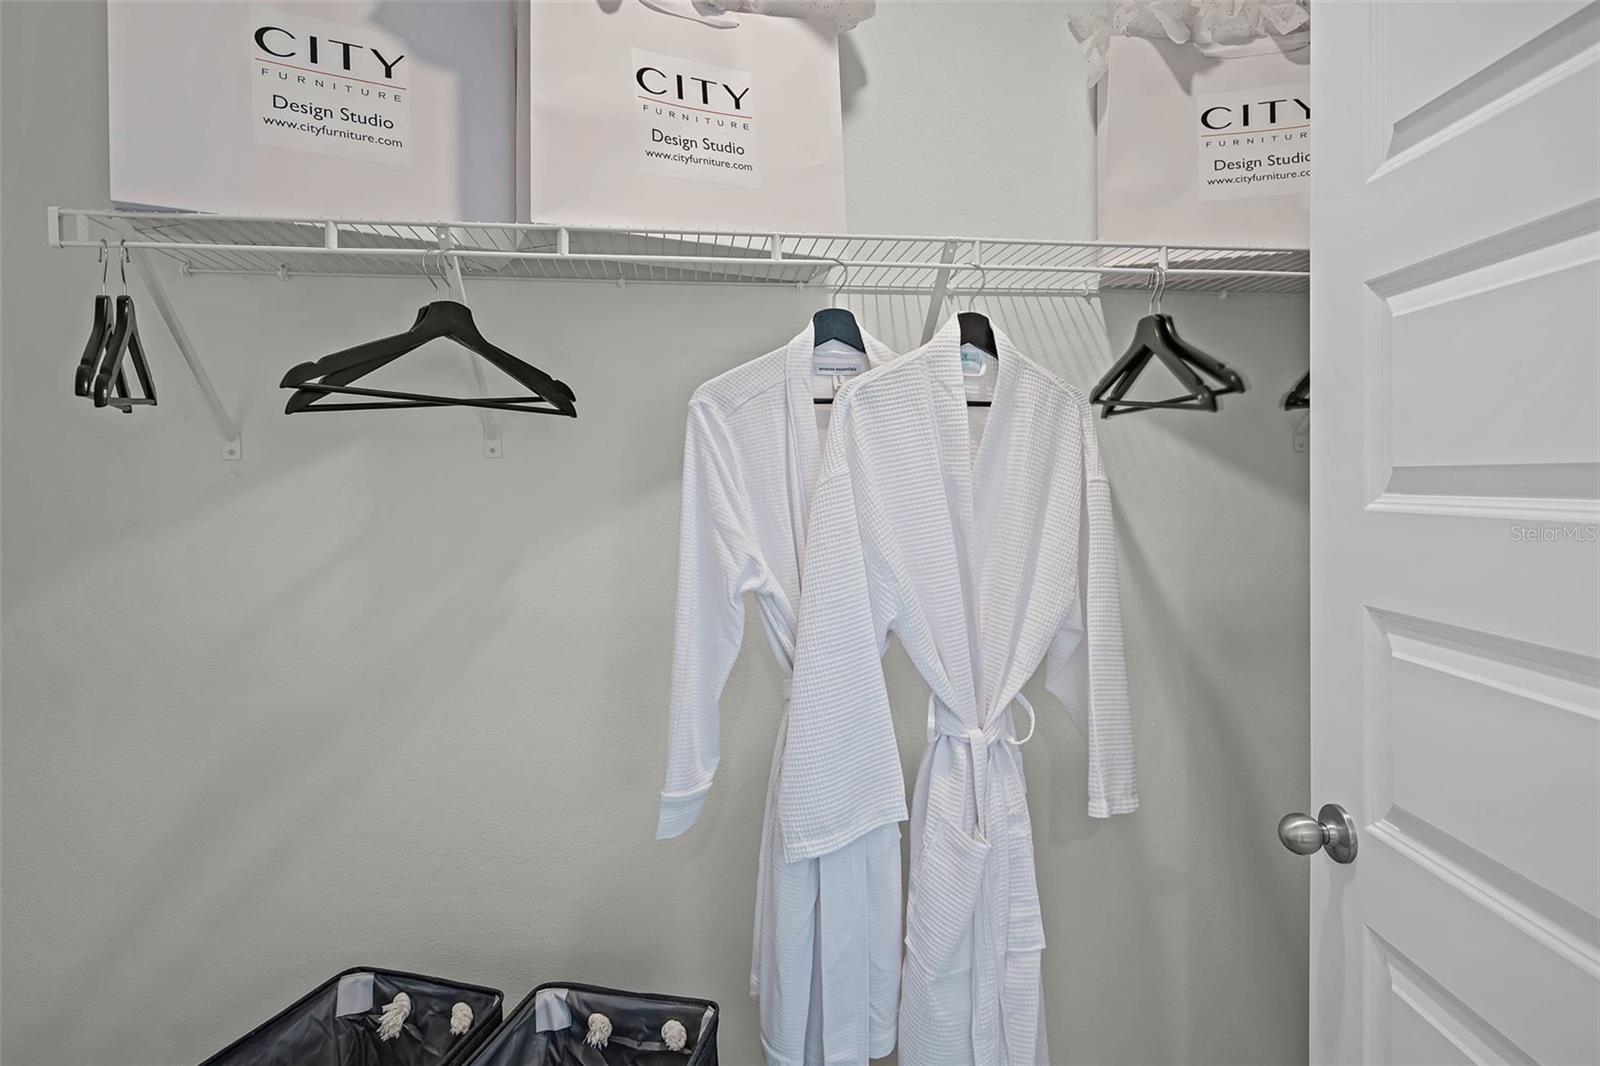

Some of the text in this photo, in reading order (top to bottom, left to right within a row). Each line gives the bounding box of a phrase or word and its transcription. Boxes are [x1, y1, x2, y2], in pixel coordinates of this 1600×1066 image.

[253, 26, 405, 79] CITY
[261, 67, 402, 103] FURNITURE
[635, 66, 750, 110] CITY
[272, 93, 394, 129] Design Studio
[642, 104, 750, 131] FURNITURE
[1200, 98, 1311, 130] CITY
[262, 116, 403, 148] www.cityfurniture.com
[651, 128, 745, 156] Design Studio
[1205, 131, 1308, 148] FURNITUR
[645, 149, 753, 172] www.cityfurniture.com
[1214, 158, 1262, 171] Design
[1206, 169, 1311, 185] www.cityfurniture.co
